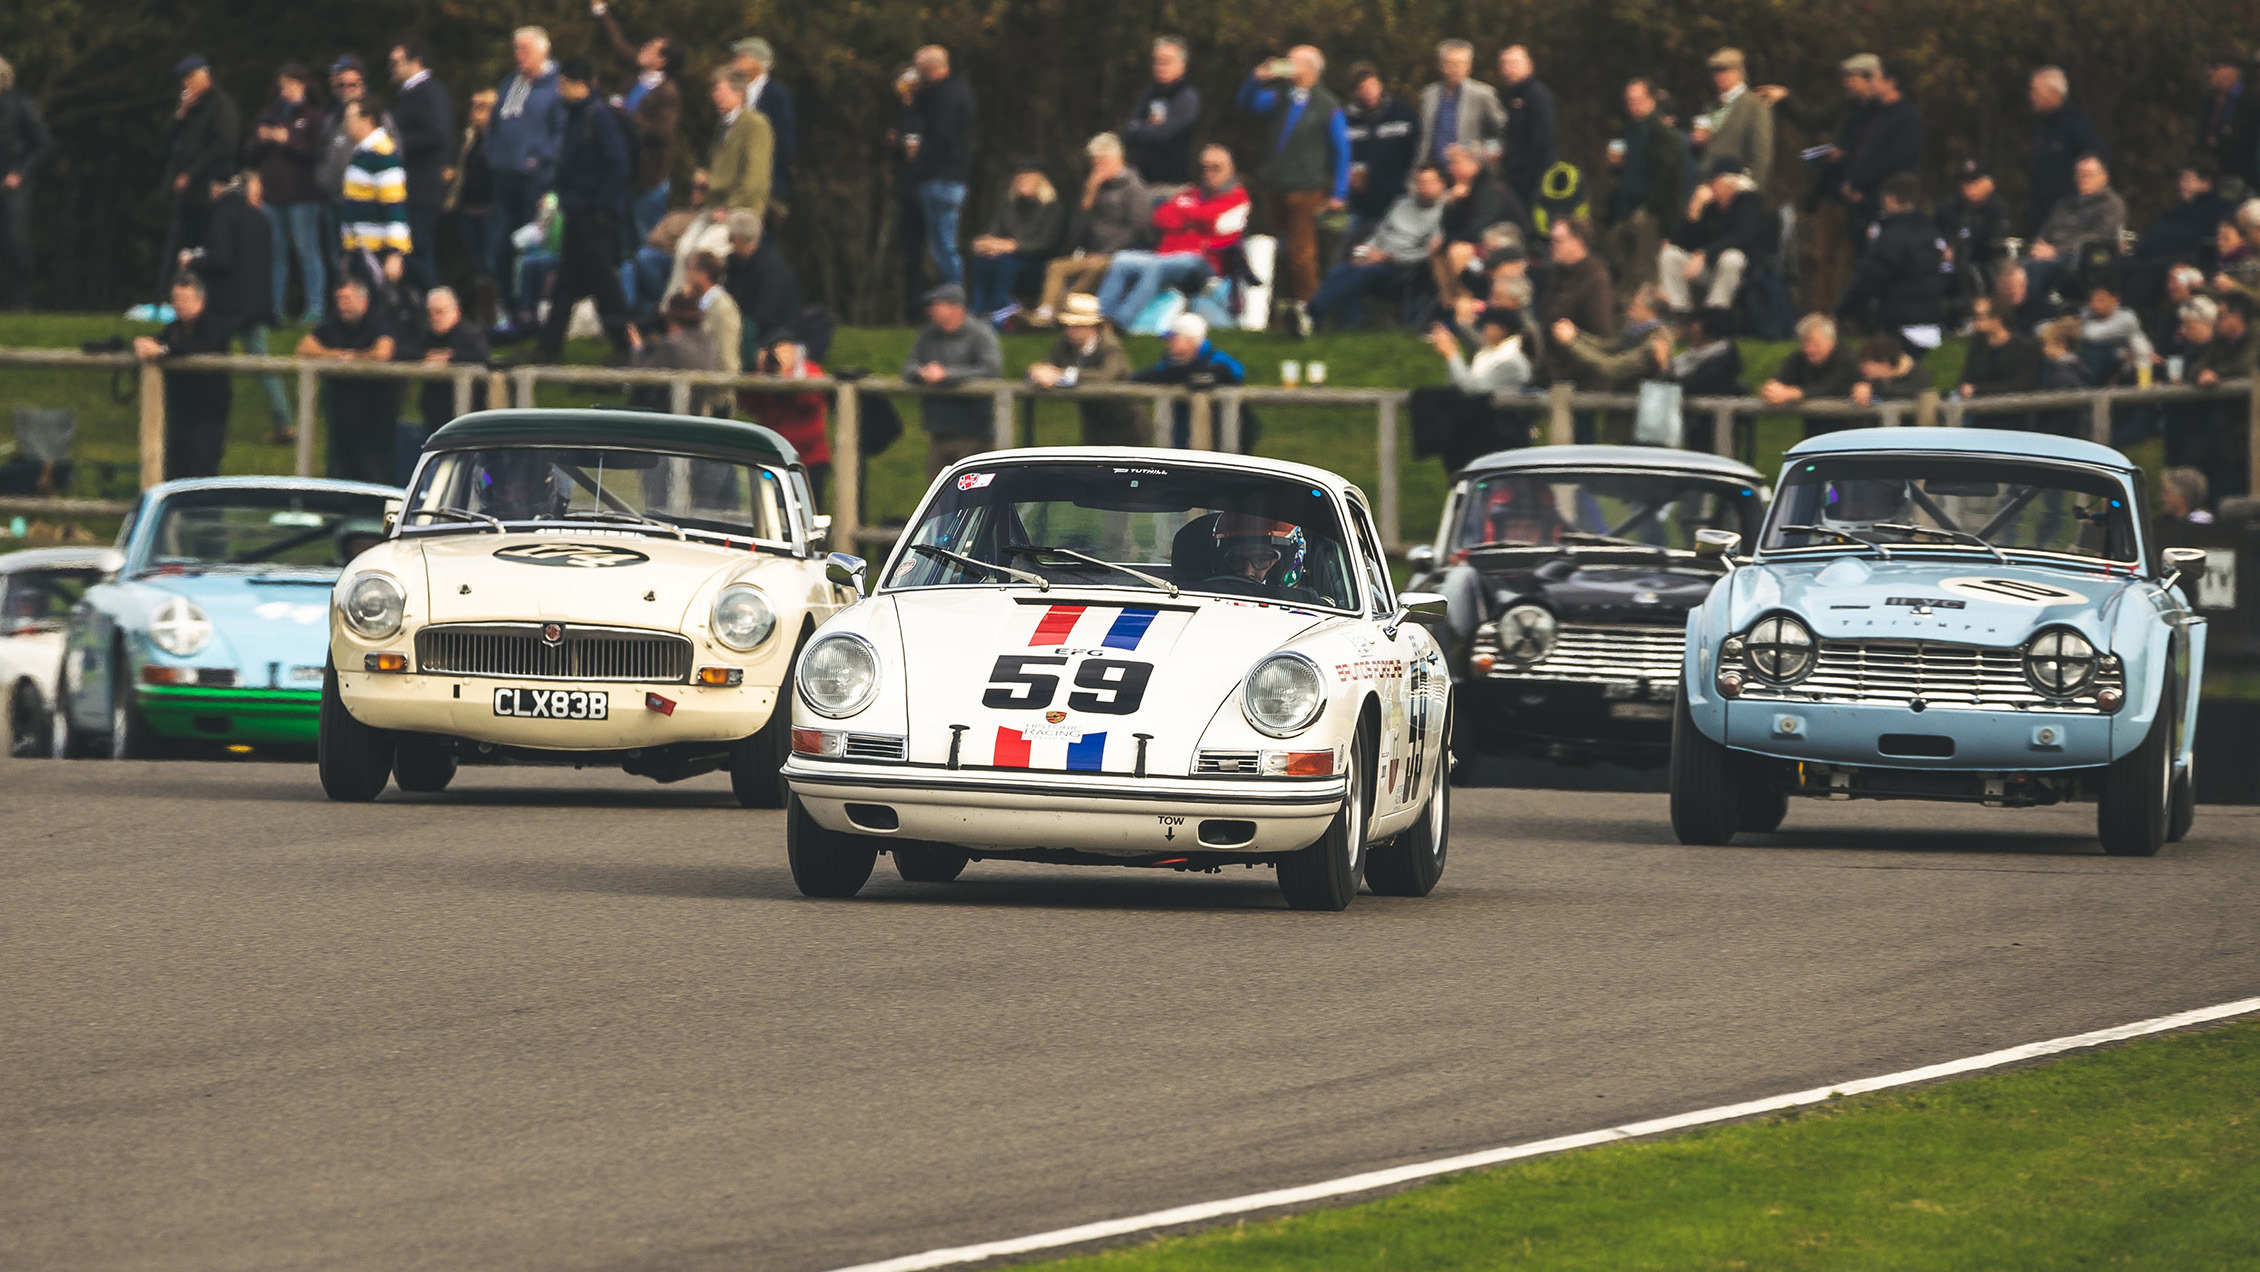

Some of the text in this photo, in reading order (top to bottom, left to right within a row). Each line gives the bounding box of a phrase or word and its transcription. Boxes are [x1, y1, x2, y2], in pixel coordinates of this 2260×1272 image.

[1130, 468, 1168, 476] TUTHILL
[1957, 579, 2070, 602] 10
[1842, 620, 1996, 633] TRIUMPH
[1054, 647, 1104, 657] EFG
[982, 655, 1155, 716] 59
[494, 688, 607, 719] CLX83B
[1024, 728, 1081, 738] RACING
[1157, 815, 1185, 825] TOW
